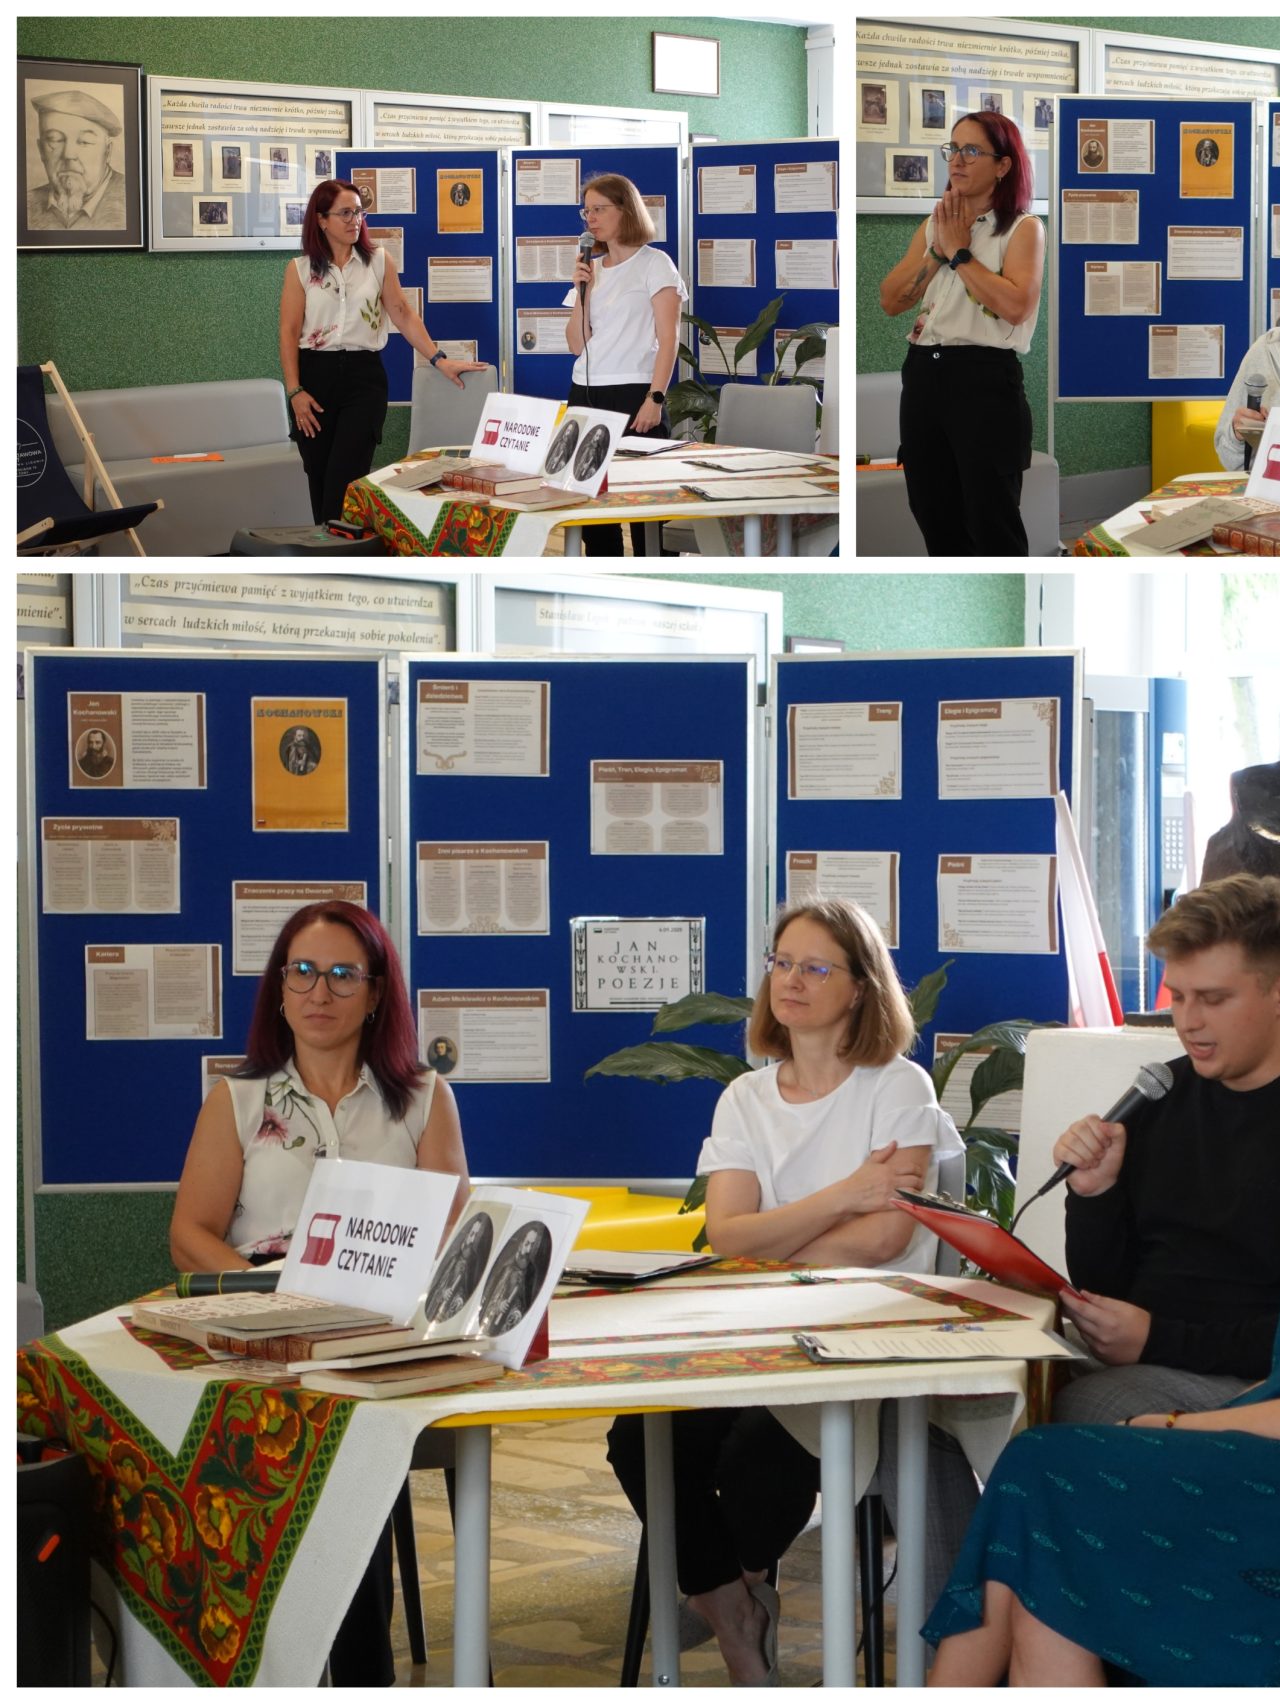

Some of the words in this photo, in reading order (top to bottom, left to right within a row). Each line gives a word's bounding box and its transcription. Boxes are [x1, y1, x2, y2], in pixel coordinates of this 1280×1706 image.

[882, 34, 907, 44] chwila
[938, 39, 954, 48] trwa
[878, 58, 902, 70] jednak
[905, 63, 940, 72] zostawia
[504, 421, 541, 438] NARODOWE
[500, 436, 530, 452] CZYTANIE
[134, 576, 170, 588] „Czas
[174, 577, 238, 594] przyćmiewa
[240, 584, 276, 600] pamięć
[280, 589, 287, 598] z
[290, 588, 343, 602] wyjątkiem
[348, 592, 370, 606] tego,
[374, 596, 385, 605] co
[388, 596, 433, 608] utwierdza
[124, 614, 134, 624] w
[138, 616, 176, 628] sercach
[183, 616, 229, 632] ludzkich
[232, 620, 266, 635] miłość,
[272, 622, 300, 638] którą
[302, 626, 356, 642] przekazują
[360, 629, 386, 641] sobie
[72, 709, 118, 717] Kochanowski
[615, 941, 657, 955] JAN
[598, 977, 680, 990] POEZJE
[345, 1216, 419, 1248] NARODOWE
[337, 1248, 397, 1279] CZYTANIE
